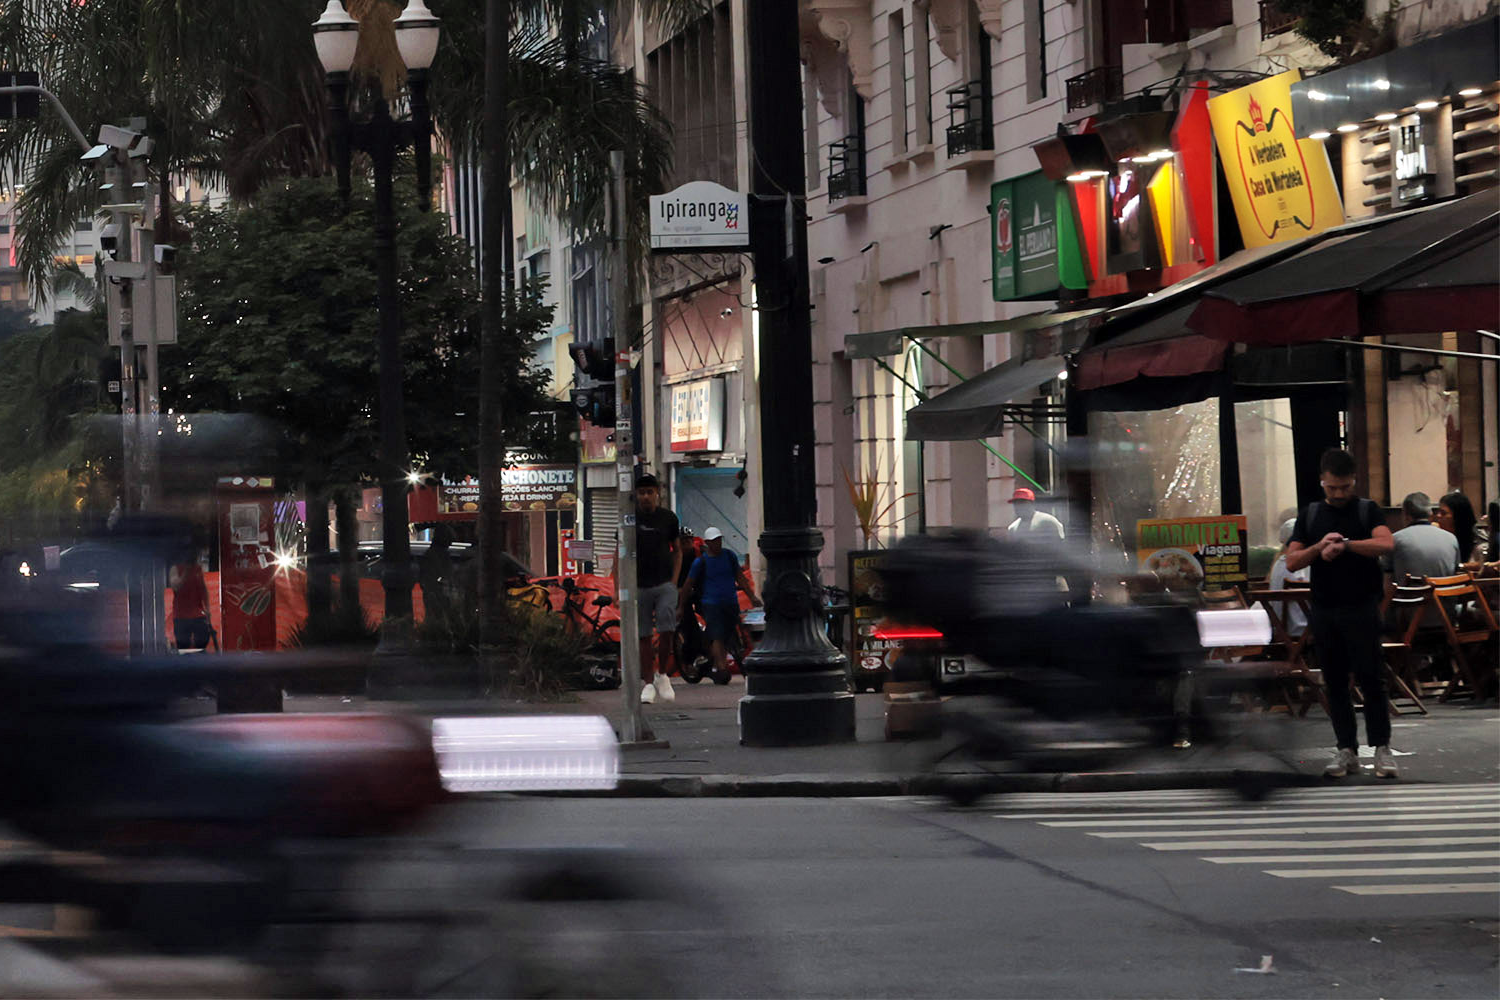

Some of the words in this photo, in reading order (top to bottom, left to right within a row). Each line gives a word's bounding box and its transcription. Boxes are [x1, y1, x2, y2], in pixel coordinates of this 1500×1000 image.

[661, 199, 726, 223] Ipiranga
[501, 469, 575, 485] NCHONETE
[533, 485, 568, 493] LANCHES
[526, 493, 553, 501] DRINKS
[1141, 522, 1239, 547] MARMITEX
[1197, 543, 1241, 558] Viagem
